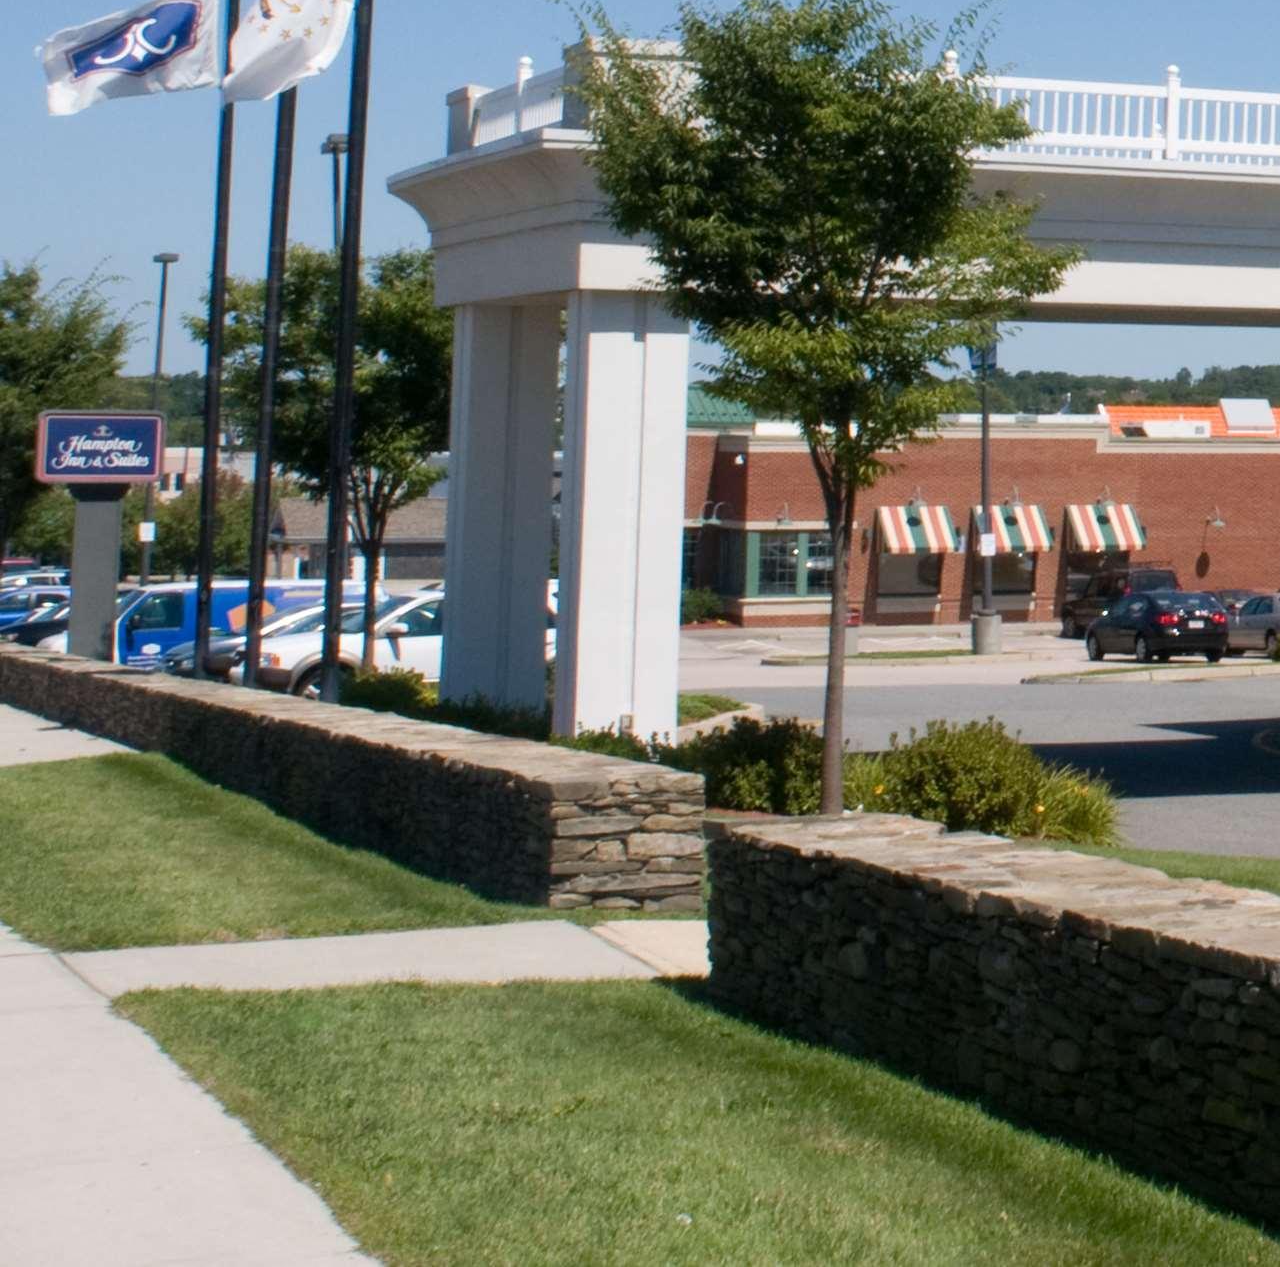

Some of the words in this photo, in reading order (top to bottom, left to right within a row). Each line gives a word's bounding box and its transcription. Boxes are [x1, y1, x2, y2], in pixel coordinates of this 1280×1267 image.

[59, 435, 142, 453] Hampton
[51, 452, 93, 469] Inn
[92, 457, 104, 468] &
[104, 452, 149, 467] Suites
